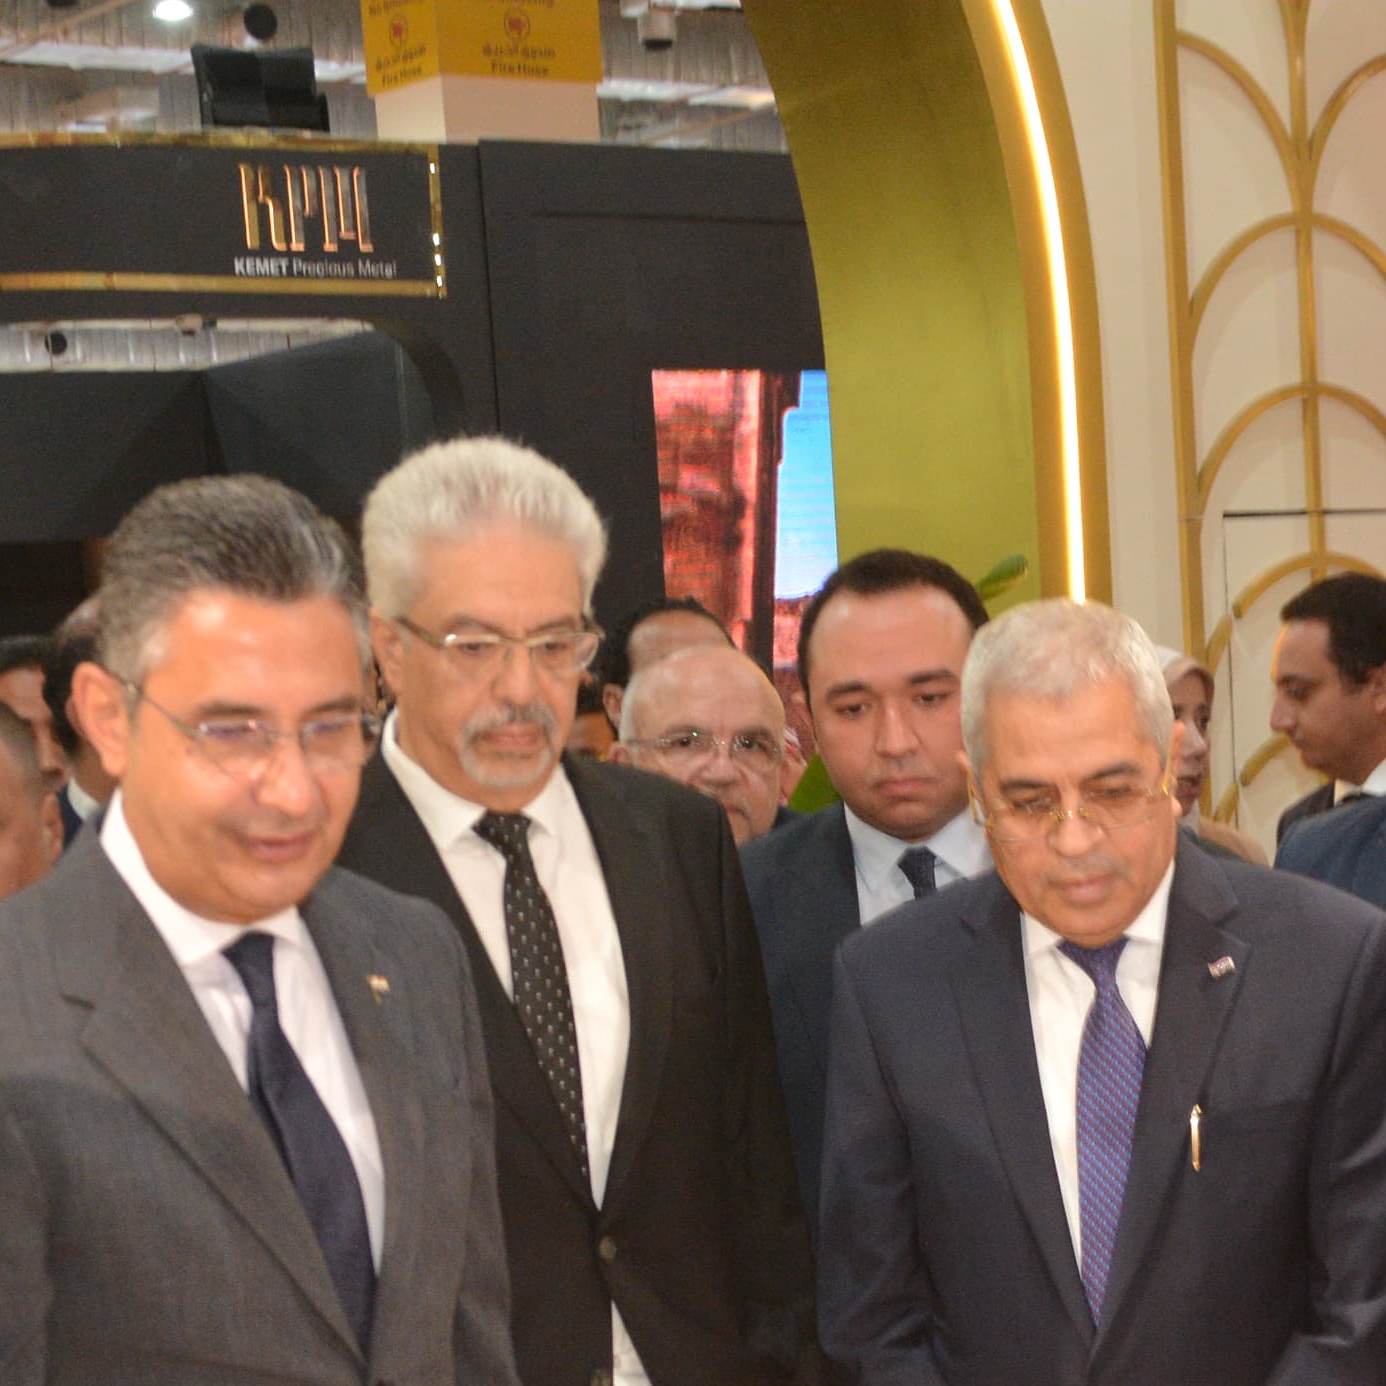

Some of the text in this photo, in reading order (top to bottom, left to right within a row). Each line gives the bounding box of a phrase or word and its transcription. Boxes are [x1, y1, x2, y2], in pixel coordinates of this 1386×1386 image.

[233, 256, 398, 279] KEMET Precious Metal
